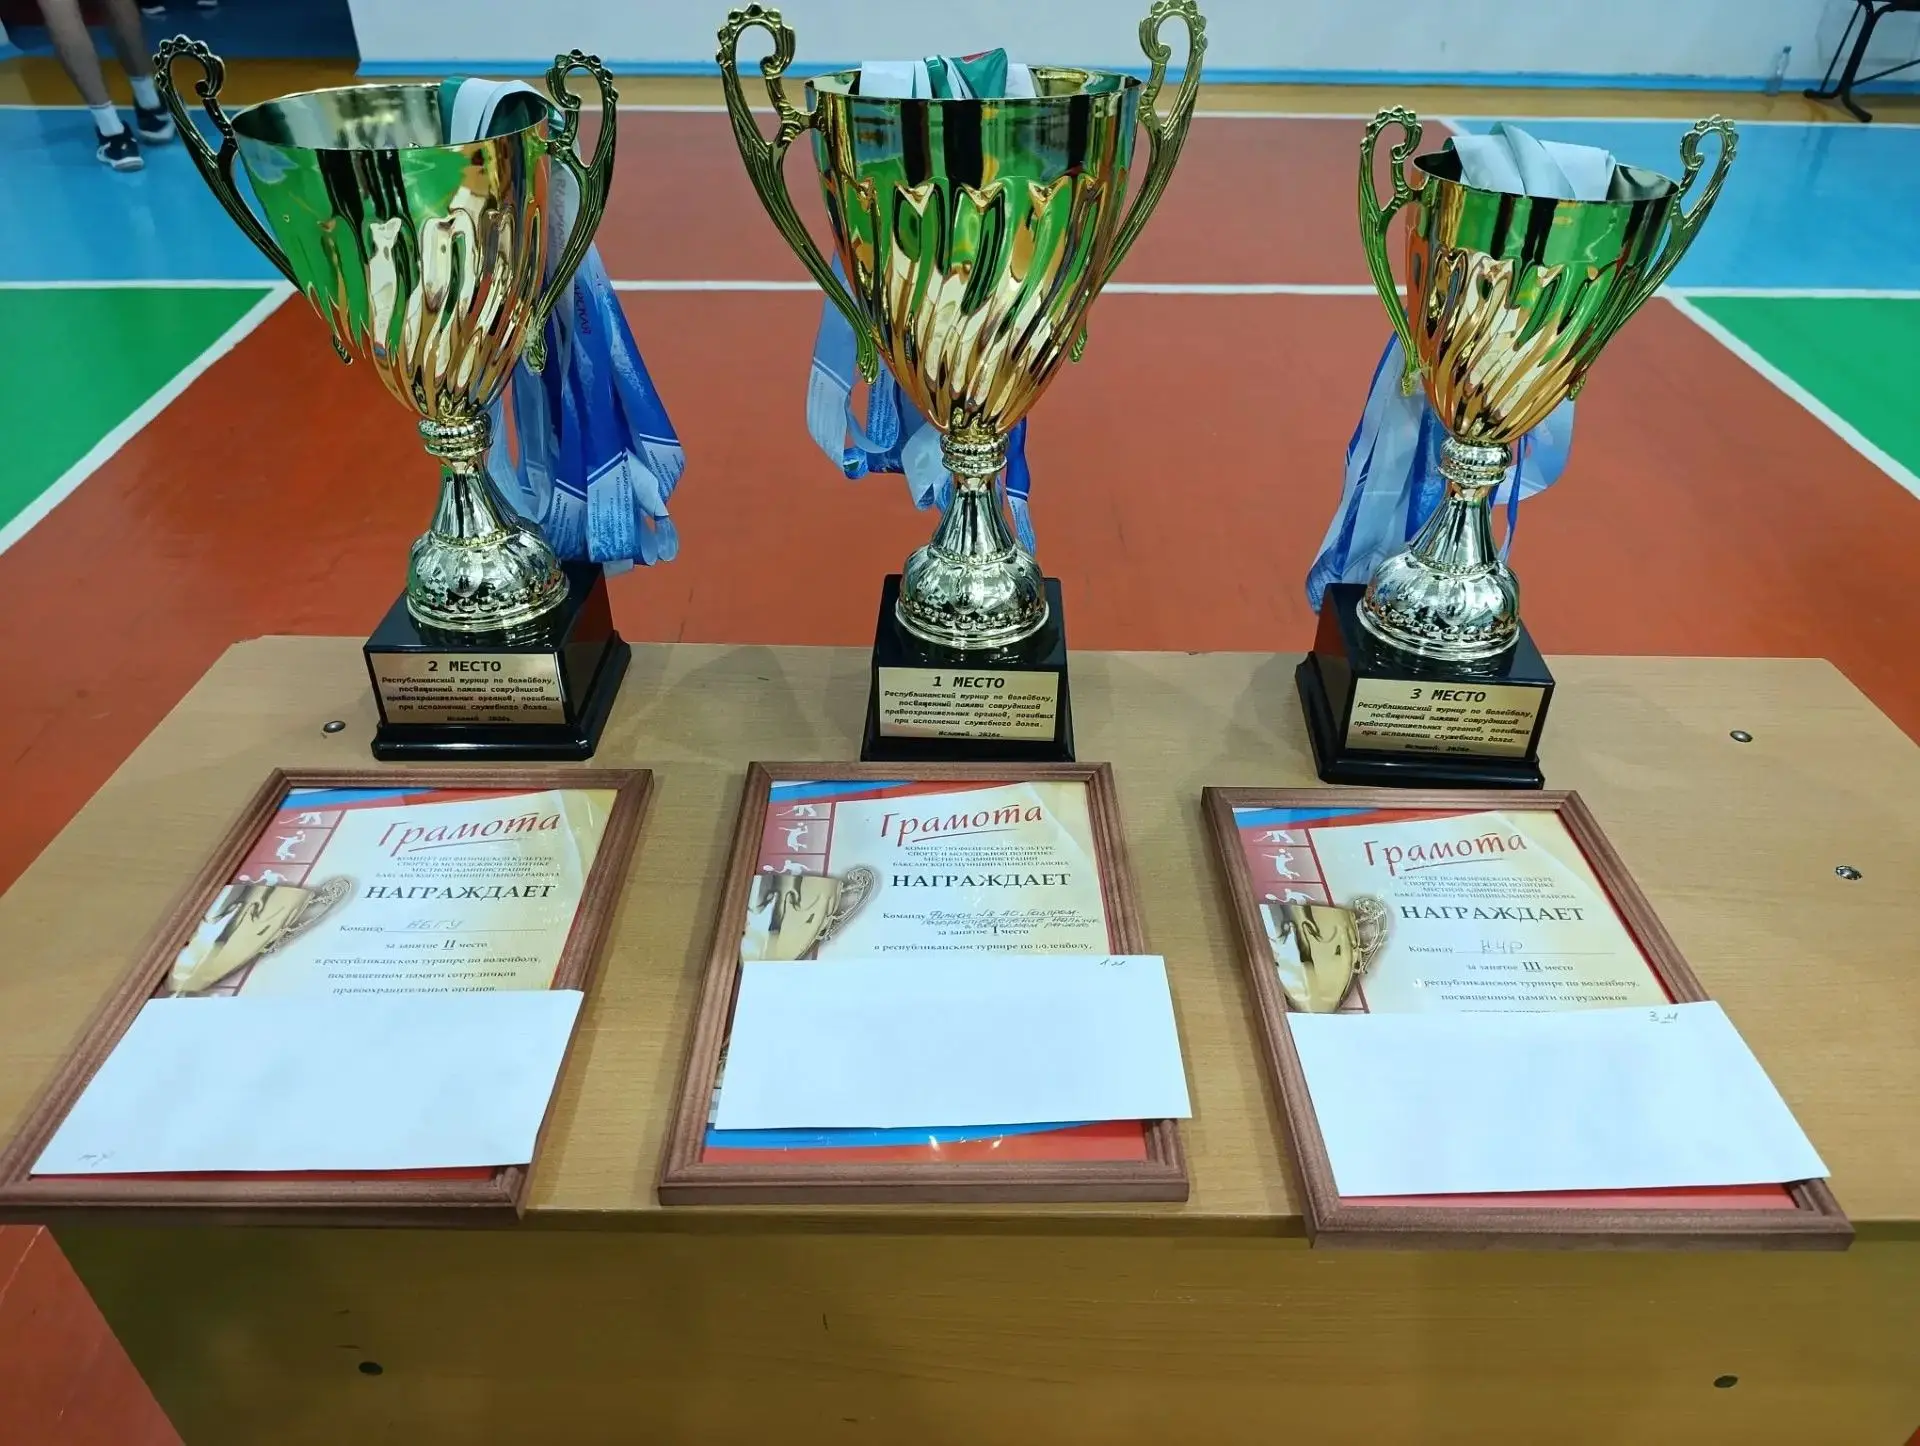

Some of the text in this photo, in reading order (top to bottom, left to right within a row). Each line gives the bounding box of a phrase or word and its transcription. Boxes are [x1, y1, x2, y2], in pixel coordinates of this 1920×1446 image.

[428, 660, 501, 672] 2 МЕСТО
[932, 676, 1005, 689] 1 МЕСТО
[884, 690, 956, 699] Республиканский
[960, 693, 990, 701] турнир
[1007, 693, 1054, 702] волейболу,
[1411, 688, 1486, 703] 3 МЕСТО
[988, 702, 1041, 710] сотрудников
[1357, 702, 1432, 712] Республиканский
[1485, 708, 1533, 718] волейболу,
[964, 720, 1012, 728] служебного
[880, 804, 1043, 847] Грамота
[378, 812, 561, 857] Грамота
[1363, 832, 1528, 876] Грамота
[892, 873, 1071, 888] НАГРАЖДАЕТ
[364, 885, 556, 901] НАГРАЖДАЕТ
[883, 912, 926, 920] Команду
[1400, 905, 1586, 922] НАГРАЖДАЕТ
[339, 925, 384, 933] Команду
[1408, 945, 1454, 954] Команду
[323, 957, 419, 966] республиканском
[1424, 979, 1518, 988] республиканском
